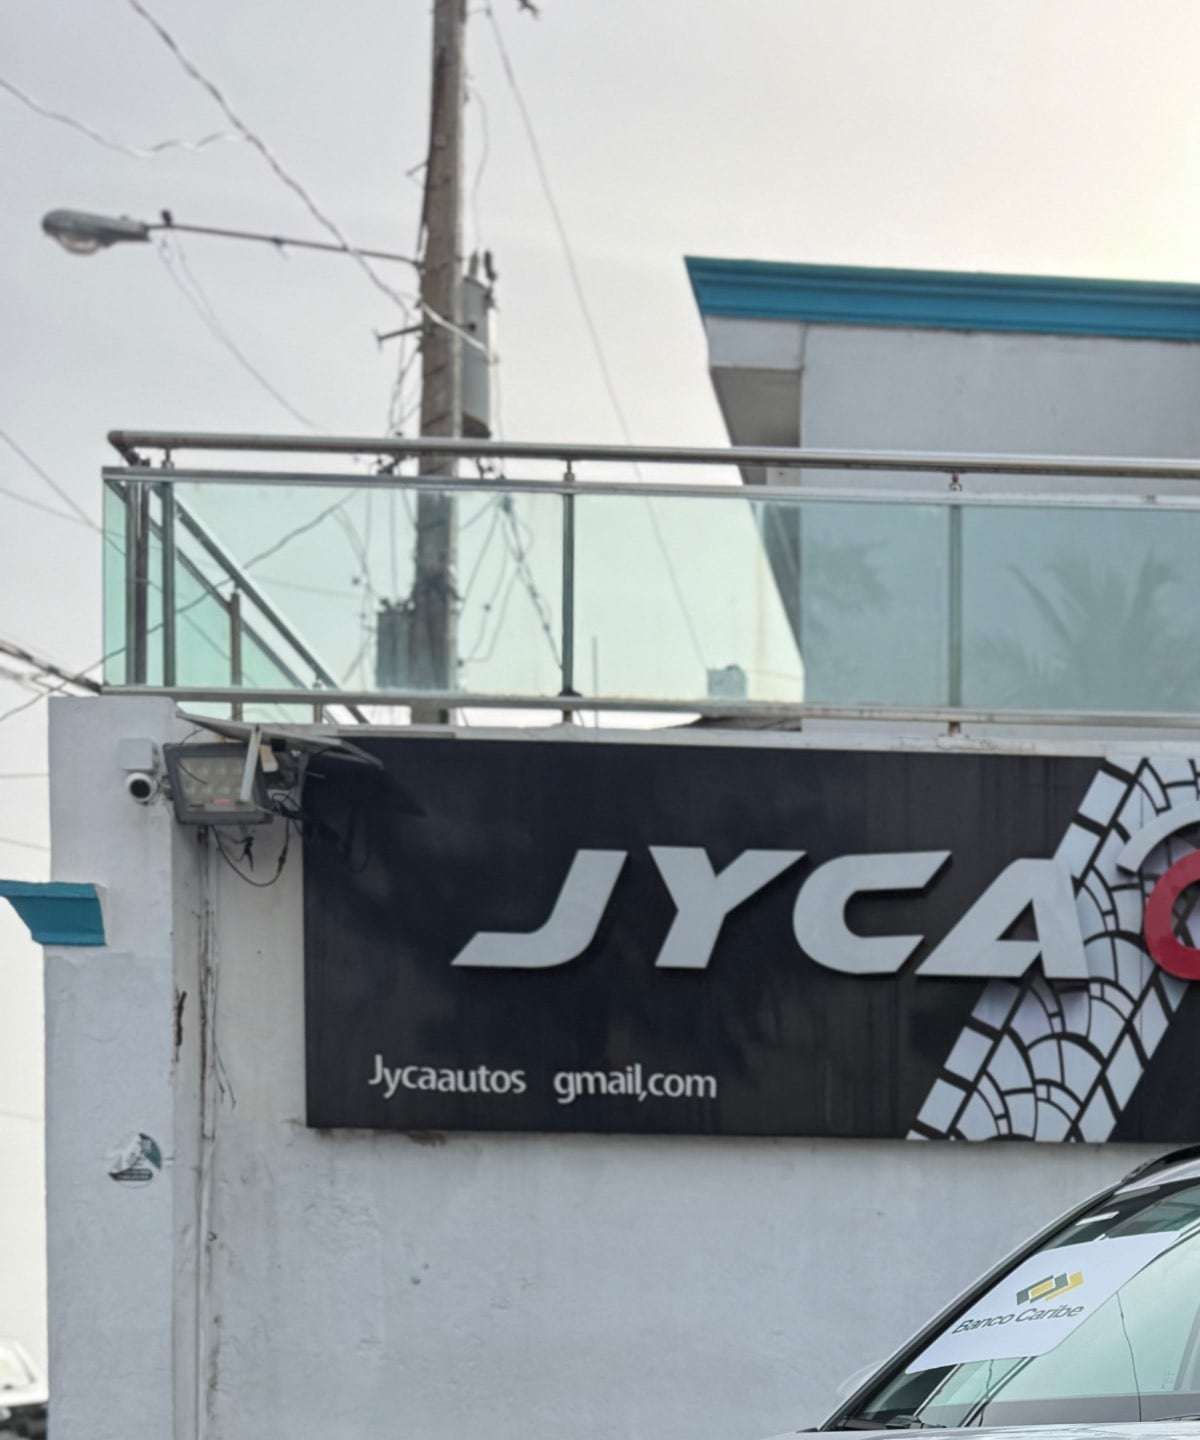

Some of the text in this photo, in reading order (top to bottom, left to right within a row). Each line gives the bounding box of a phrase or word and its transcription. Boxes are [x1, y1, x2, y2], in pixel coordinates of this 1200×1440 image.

[369, 1054, 527, 1099] Jycaautos
[951, 1304, 1085, 1335] Banco Caribe
